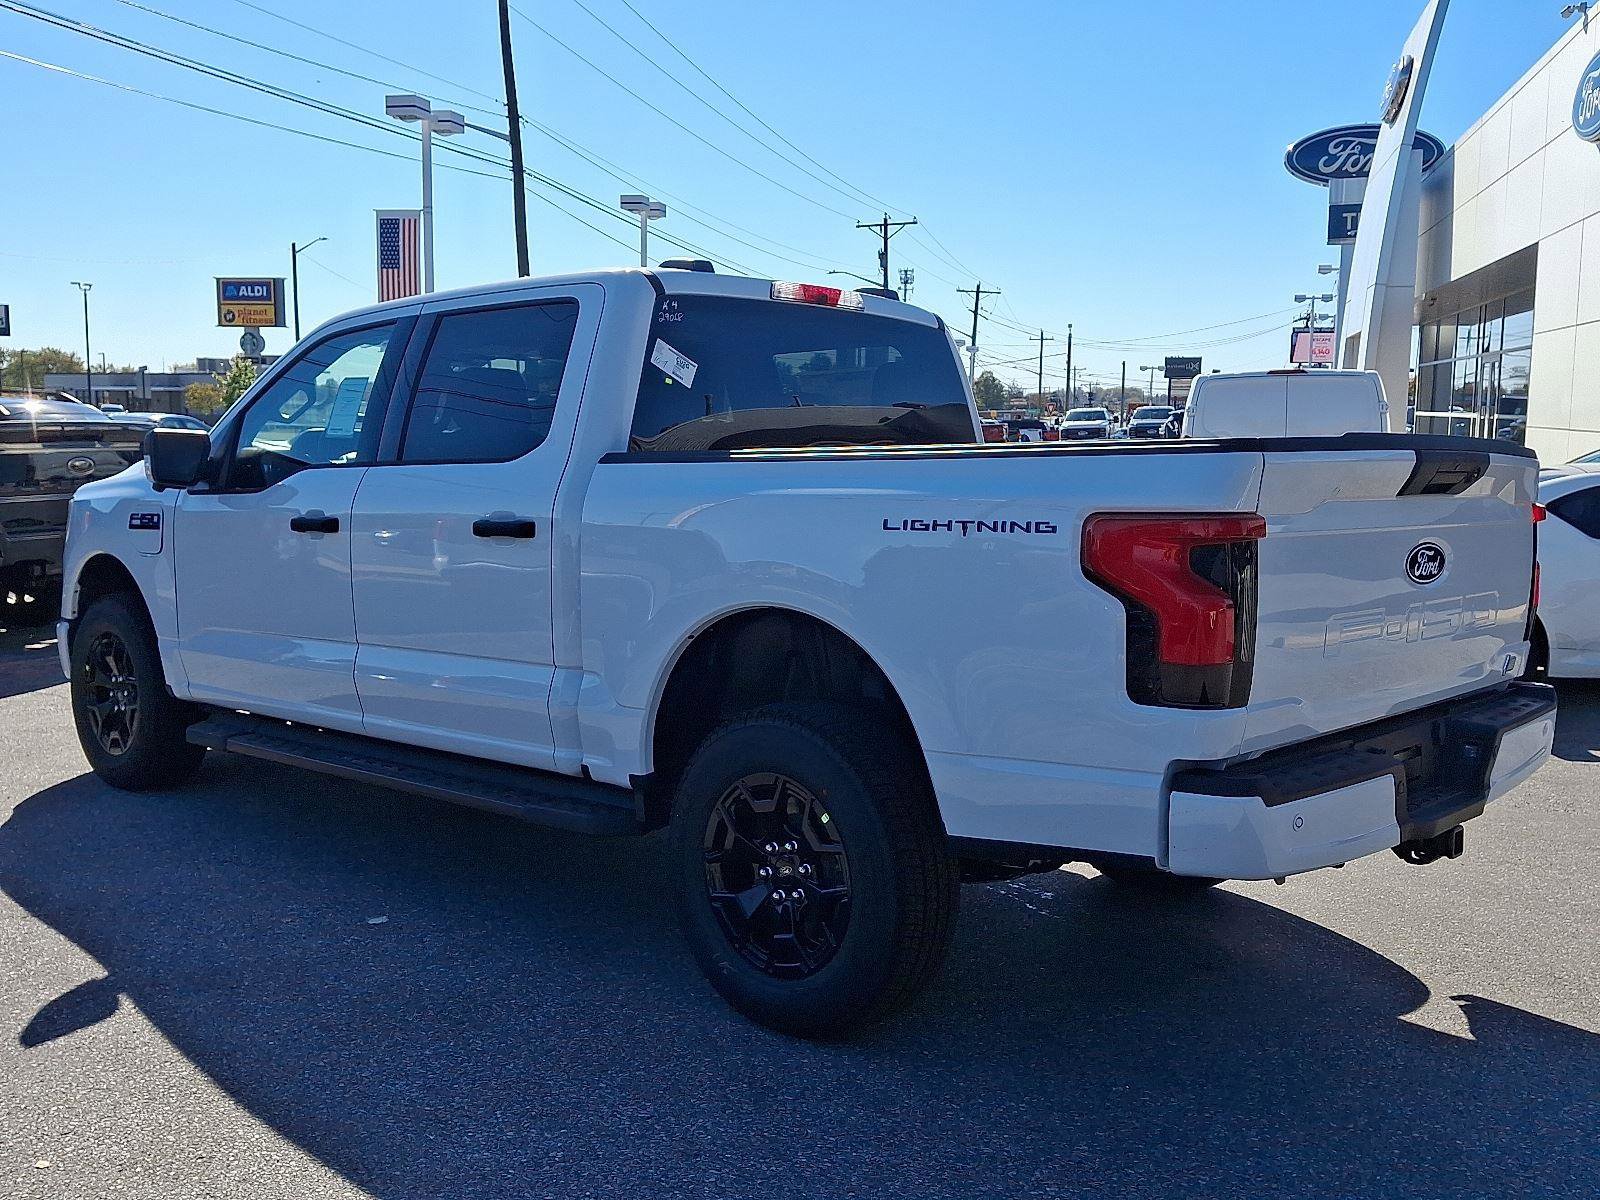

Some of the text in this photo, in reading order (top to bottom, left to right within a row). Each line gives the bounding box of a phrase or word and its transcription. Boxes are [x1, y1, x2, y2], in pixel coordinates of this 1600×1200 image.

[1318, 136, 1378, 173] For
[239, 286, 267, 297] ALDI
[237, 308, 268, 318] planet
[241, 316, 274, 324] fitness
[883, 519, 1058, 537] LIGHTNING
[1414, 549, 1441, 577] Ford
